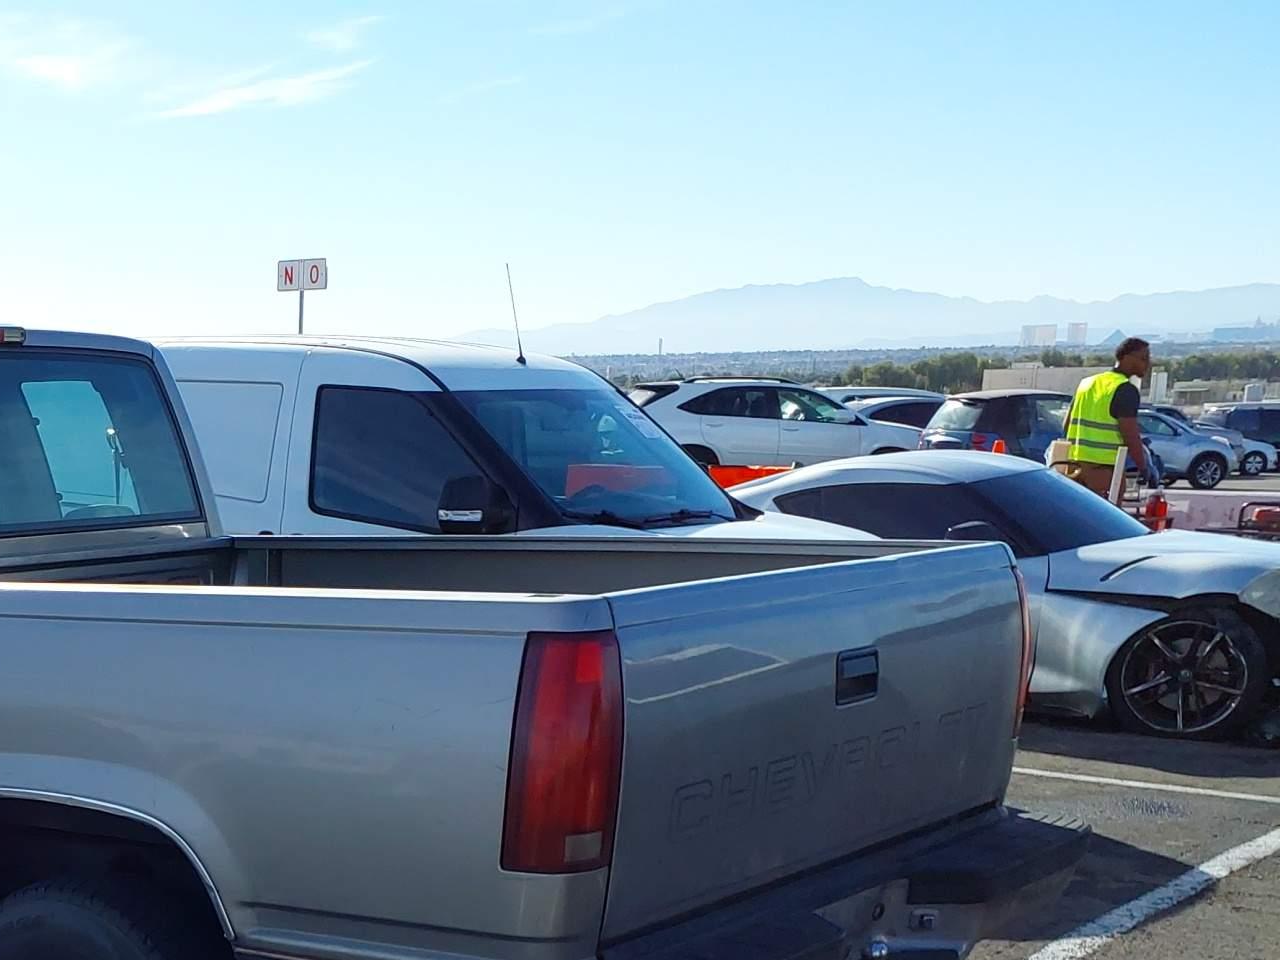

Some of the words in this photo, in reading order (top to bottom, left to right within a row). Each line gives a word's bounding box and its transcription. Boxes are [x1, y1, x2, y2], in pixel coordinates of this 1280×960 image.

[284, 266, 293, 285] N
[310, 264, 319, 284] O
[667, 702, 989, 845] CHEVROLET
